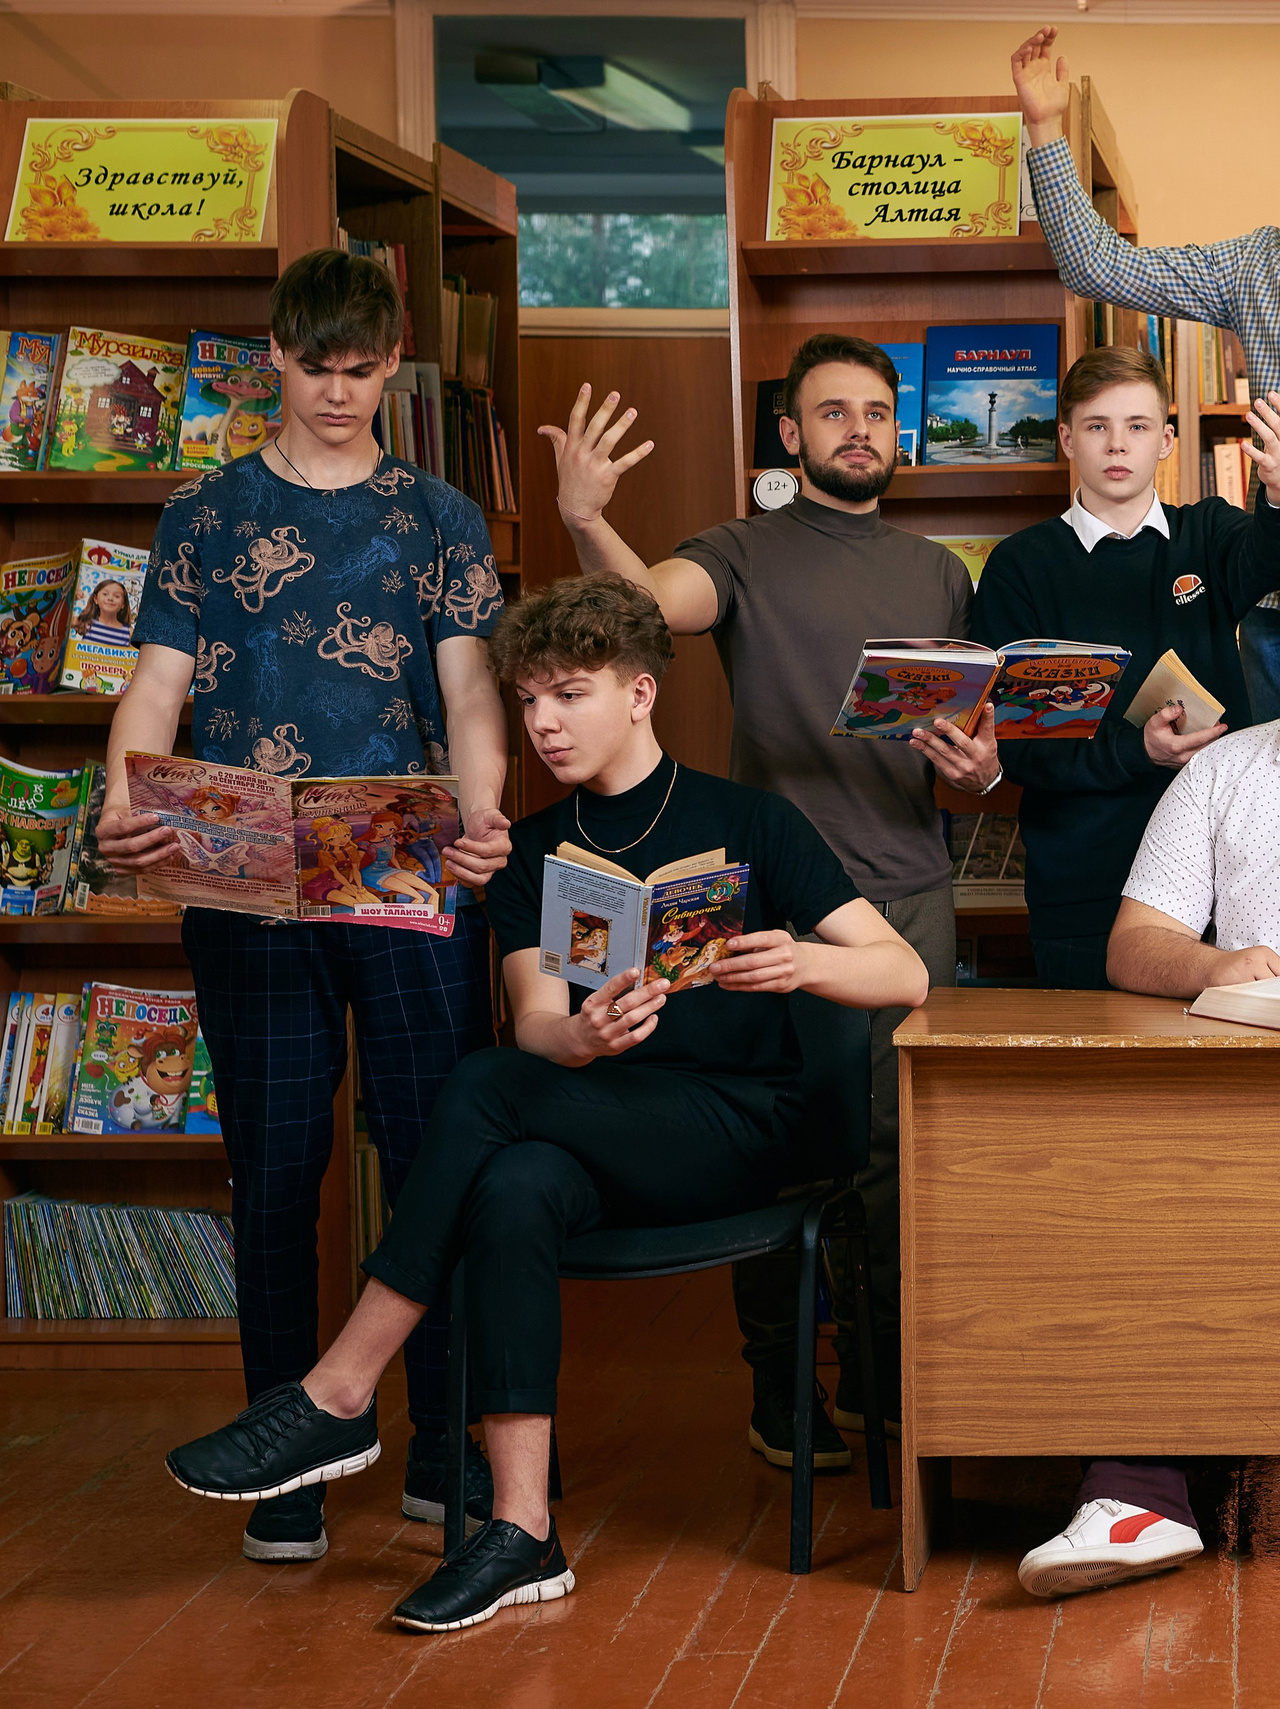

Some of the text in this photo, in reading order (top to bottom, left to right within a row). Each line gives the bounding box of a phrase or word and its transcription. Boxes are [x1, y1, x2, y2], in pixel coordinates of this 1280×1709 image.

[831, 150, 946, 175] Барнаул
[75, 165, 243, 191] Здравствуй,
[848, 179, 962, 199] столица
[109, 199, 205, 221] школа!
[864, 203, 961, 226] Алтая
[76, 331, 185, 367] Мурзилка
[954, 349, 1031, 361] БАРНАУЛ
[947, 365, 1016, 373] НАУЧНО-СПРАВОЧНЫЙ
[767, 481, 788, 491] 12+
[4, 560, 73, 591] НЕПОСЕДА
[1175, 586, 1206, 605] ellesse
[81, 662, 127, 675] ПРОВЕРЬ
[897, 670, 951, 682] СКАЗКИ
[1022, 664, 1102, 679] СКАЗКИ
[219, 776, 255, 788] СЕНТЯБРЯ
[10, 814, 74, 831] НАВСЕГДА!
[361, 908, 428, 917] ШОУ ТАЛАНТОВ
[438, 916, 451, 926] 0+
[662, 905, 722, 924] Сибирочка
[63, 1004, 74, 1016] 6
[97, 996, 191, 1028] НЕПОСЕДА
